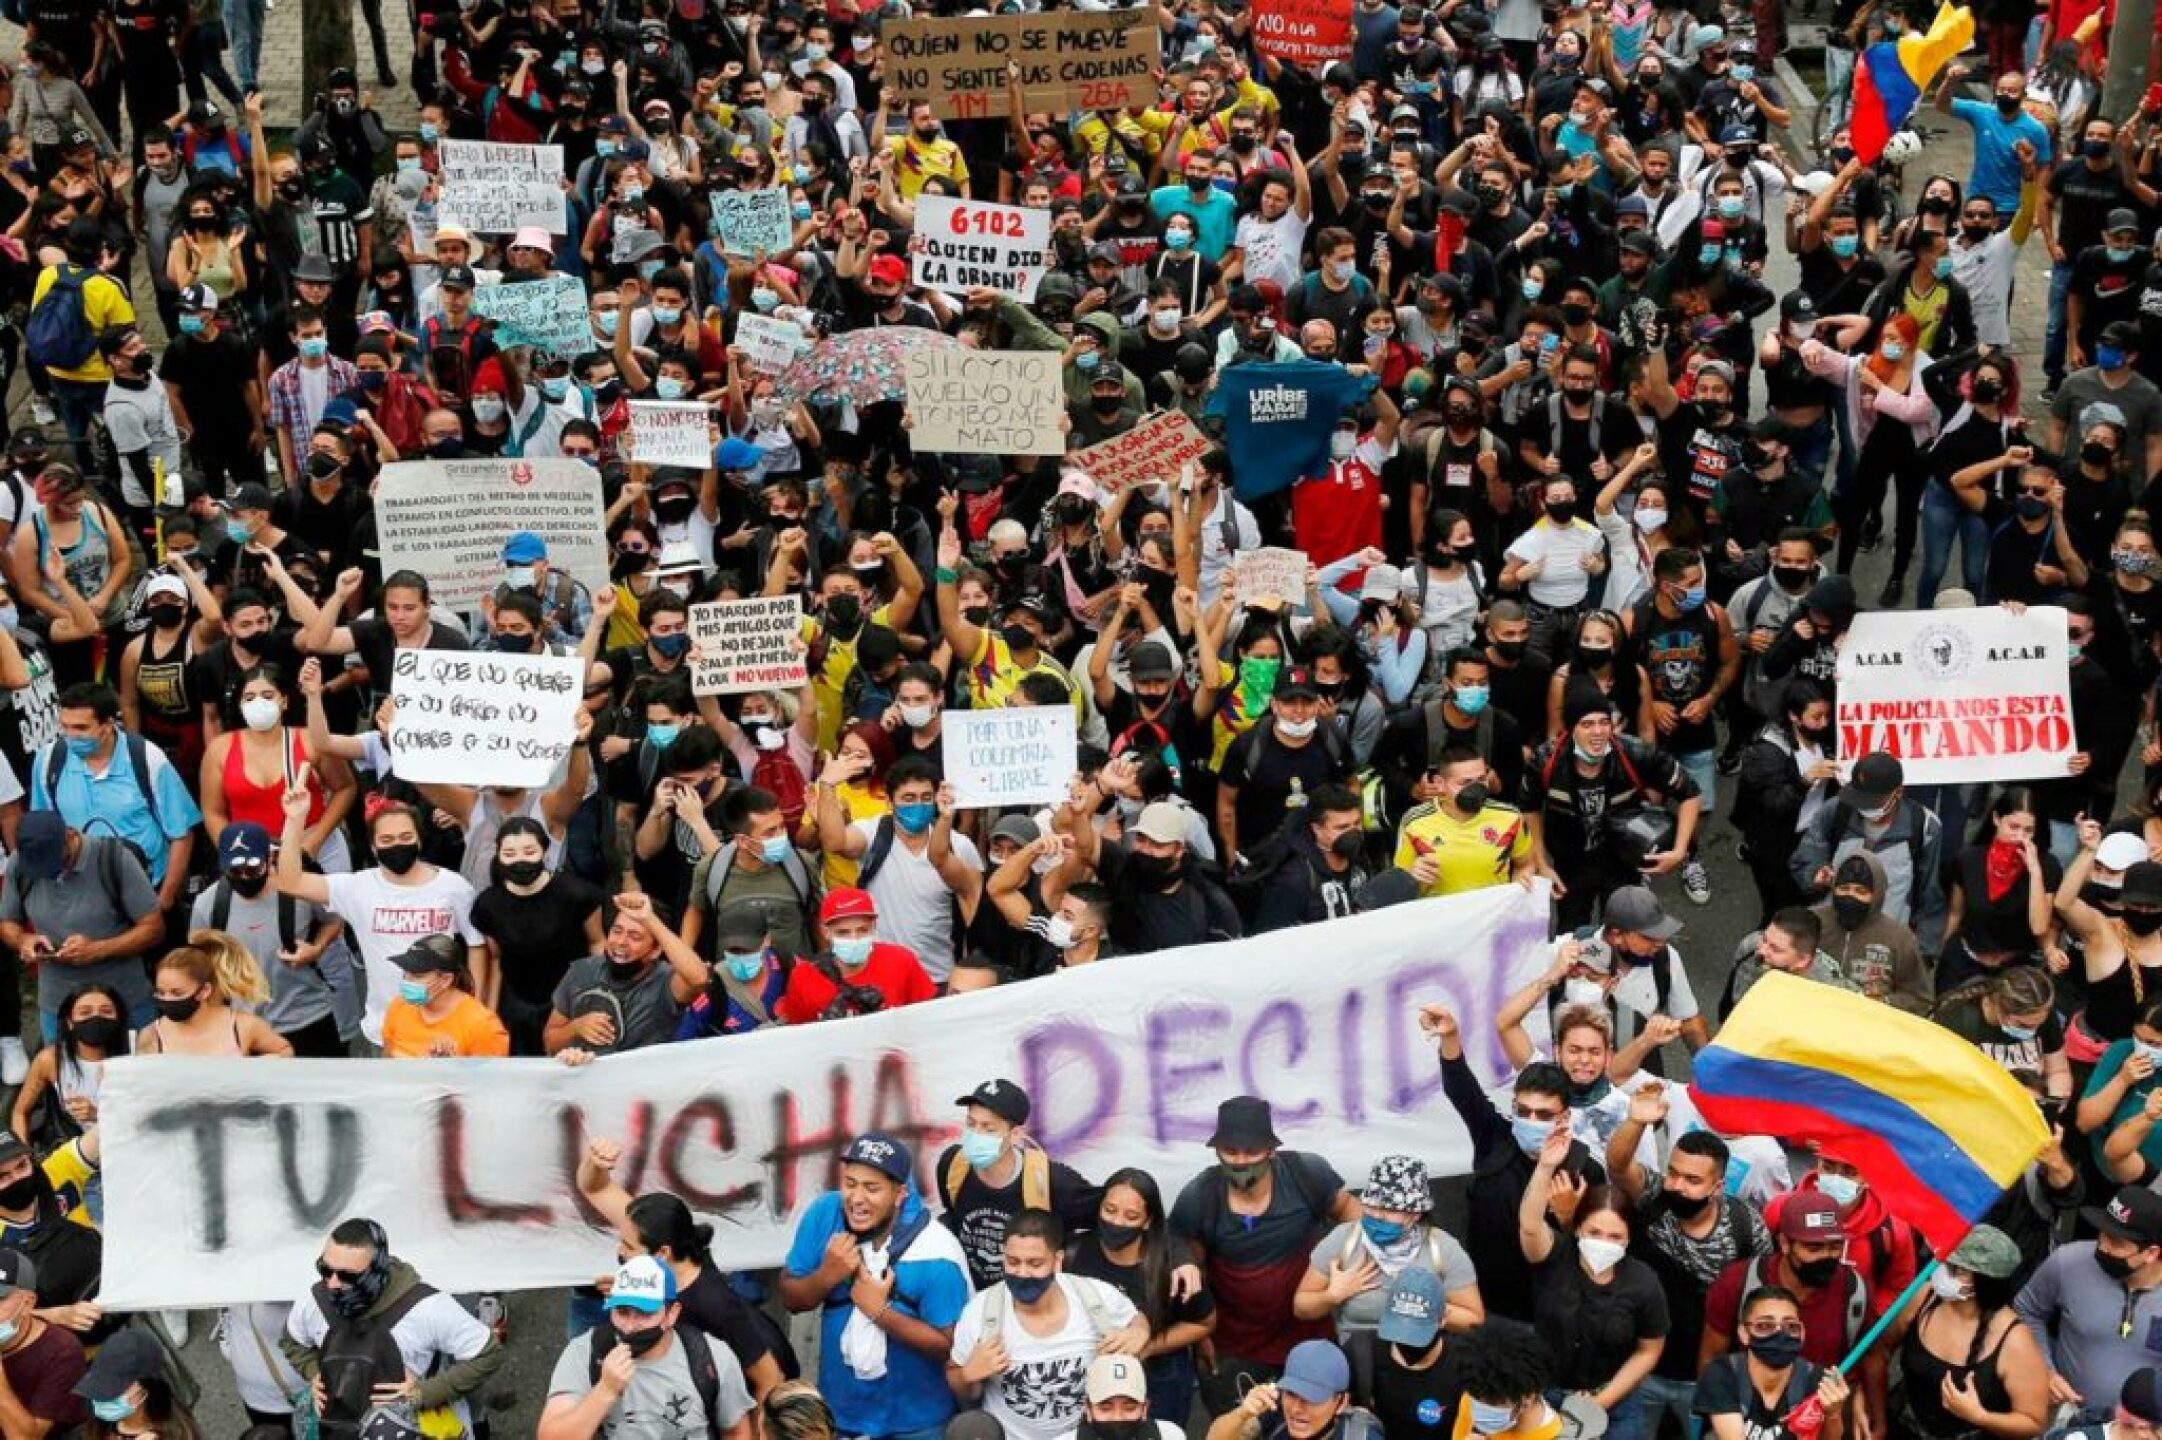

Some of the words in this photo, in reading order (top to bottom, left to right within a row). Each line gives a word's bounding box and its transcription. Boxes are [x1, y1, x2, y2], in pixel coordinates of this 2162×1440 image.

[1256, 14, 1284, 33] NO
[975, 31, 1010, 52] NO
[1020, 30, 1047, 50] SE
[1057, 28, 1128, 51] MUEVE
[896, 68, 929, 90] NO
[1022, 65, 1051, 85] LAS
[1060, 54, 1149, 83] CADENAS
[1008, 250, 1042, 267] DIO
[922, 259, 948, 284] LA
[957, 267, 1027, 294] ORDEN?
[1006, 358, 1046, 383] NO
[911, 382, 1012, 404] VUELVO
[1018, 384, 1057, 408] UN
[1249, 383, 1308, 401] URIBE
[913, 404, 1001, 426] TOMBO
[1009, 405, 1048, 428] ME
[958, 427, 1036, 450] MATO
[385, 493, 465, 508] TRABAJADORES
[467, 491, 487, 502] DEL
[489, 490, 526, 501] METRO
[528, 490, 542, 500] DE
[386, 511, 436, 523] ESTAMOS
[438, 511, 453, 521] EN
[455, 508, 511, 519] CONFLICTO
[574, 505, 594, 516] POR
[385, 528, 398, 539] LA
[401, 524, 466, 538] ESTABILIDAD
[468, 522, 514, 533] LABORAL
[516, 521, 523, 531] Y
[525, 521, 543, 531] LOS
[546, 520, 599, 531] DERECHOS
[392, 543, 406, 552] DE
[411, 542, 432, 552] LOS
[576, 536, 594, 546] DEL
[454, 550, 498, 564] SISTEMA
[713, 603, 766, 619] MARCHO
[769, 600, 796, 615] POR
[696, 622, 721, 637] MIS
[723, 618, 771, 634] AMIGOS
[772, 616, 796, 630] QUE
[721, 639, 740, 651] NO
[478, 662, 508, 685] NO
[696, 675, 706, 687] A
[736, 669, 755, 683] NO
[508, 702, 538, 723] NO
[1840, 702, 1863, 721] LA
[1954, 698, 2000, 718] NOS
[2006, 694, 2066, 716] ESTA
[966, 720, 999, 744] POR
[1840, 715, 2071, 761] MATANDO
[989, 766, 1049, 793] LIBRE
[376, 909, 431, 932] MARVEL
[143, 1095, 360, 1252] TU
[436, 1049, 955, 1232] LUCHA
